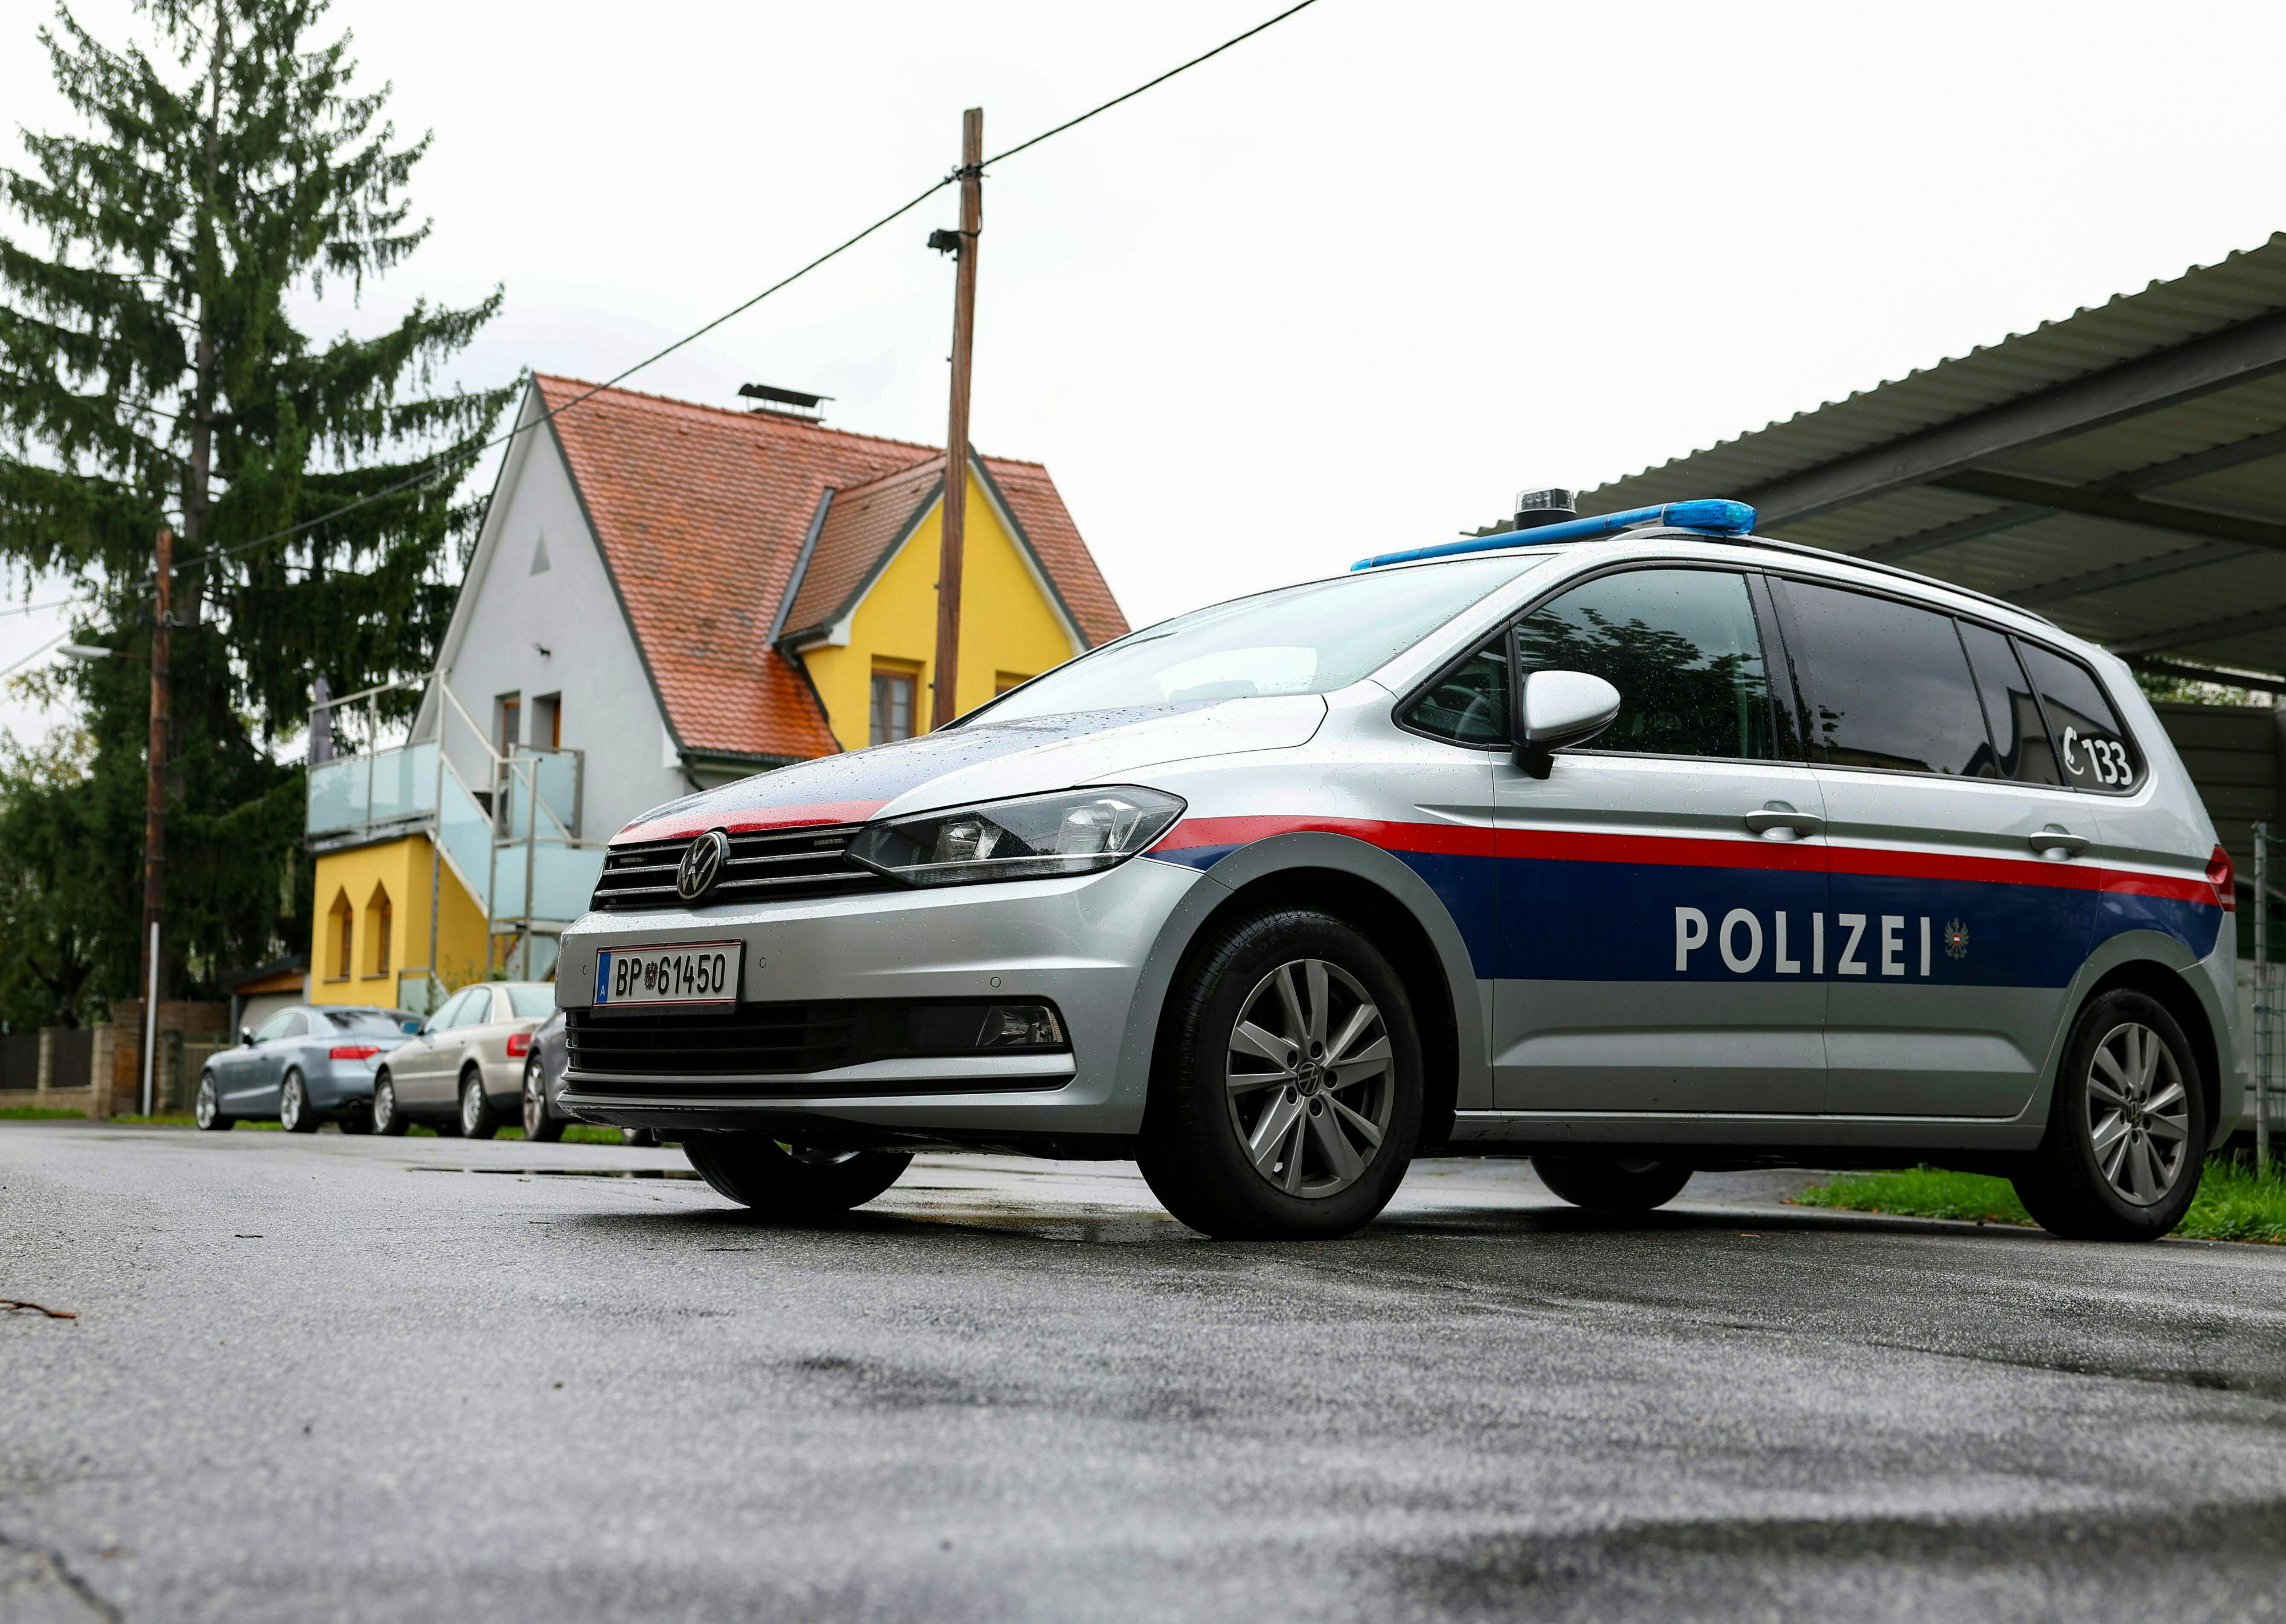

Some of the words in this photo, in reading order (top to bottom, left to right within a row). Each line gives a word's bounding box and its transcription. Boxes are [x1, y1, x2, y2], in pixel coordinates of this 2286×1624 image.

[2081, 739, 2133, 786] 133
[1676, 906, 1931, 976] POLIZEI
[600, 986, 605, 996] A
[616, 958, 642, 996] BP
[658, 953, 725, 994] 61450
